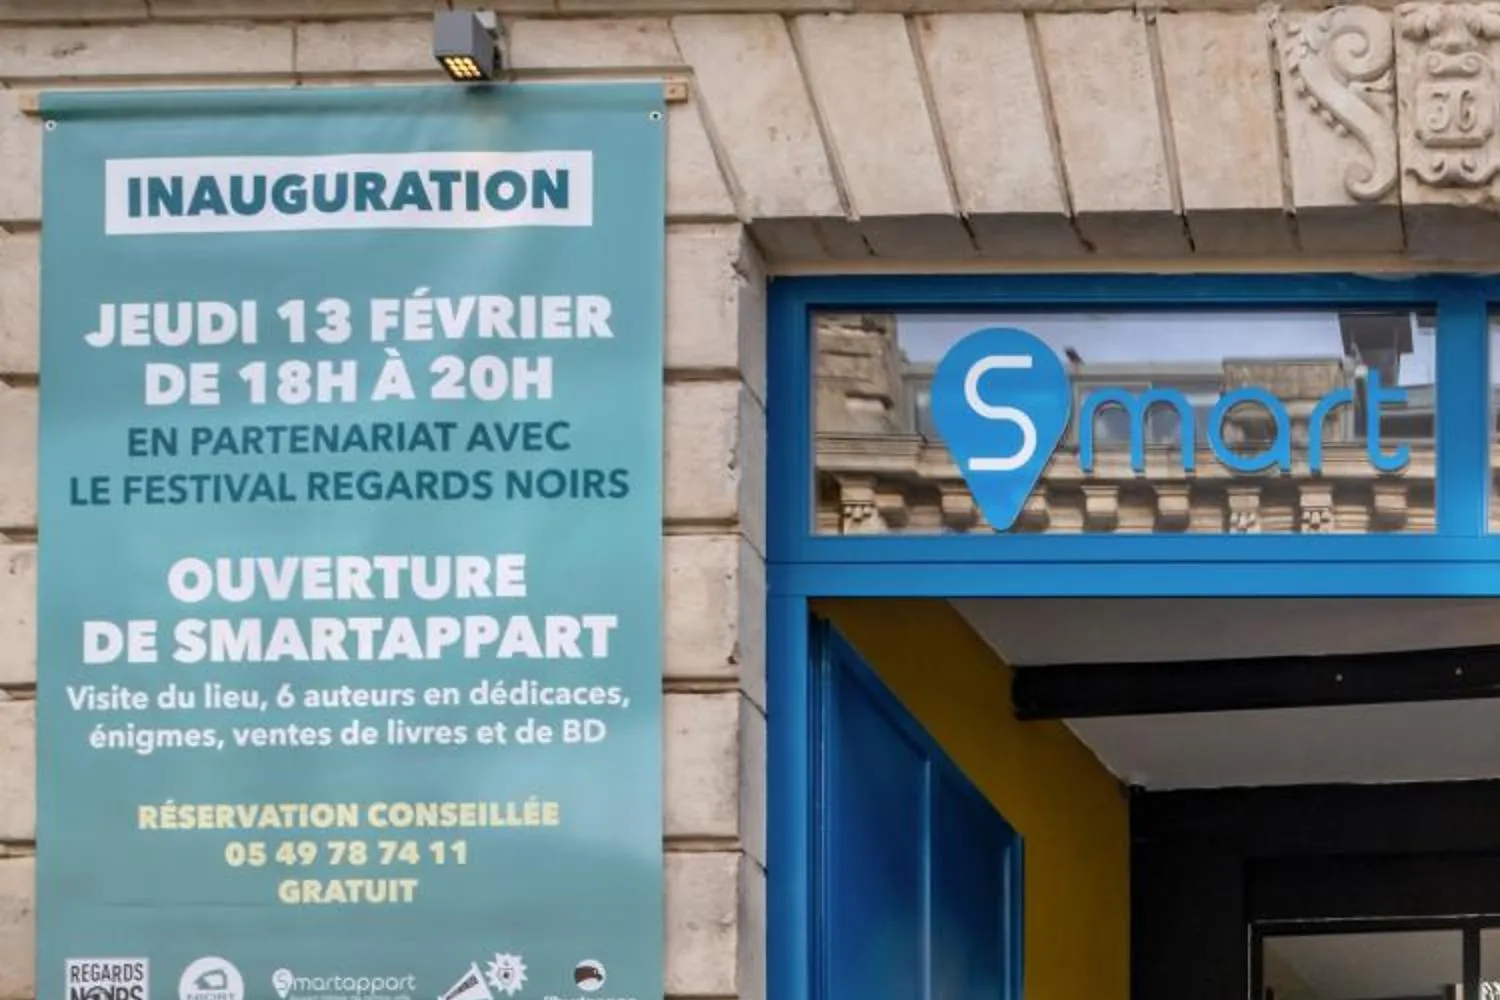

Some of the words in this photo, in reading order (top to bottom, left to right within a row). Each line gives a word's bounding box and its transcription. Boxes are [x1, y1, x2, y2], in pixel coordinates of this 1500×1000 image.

[127, 169, 570, 218] INAUGURATION
[85, 301, 257, 347] JEUDI
[277, 298, 352, 344] 13
[370, 287, 614, 343] FÉVRIER
[145, 362, 220, 406] DE
[239, 359, 357, 404] 18H
[372, 347, 415, 401] À
[431, 356, 553, 401] 20H
[966, 355, 1412, 474] Smart
[127, 427, 178, 457] EN
[191, 423, 457, 455] PARTENARIAT
[465, 421, 571, 452] AVEC
[70, 476, 115, 507] LE
[123, 473, 298, 505] FESTIVAL
[308, 470, 494, 501] REGARDS
[506, 468, 630, 500] NOIRS
[167, 554, 527, 602] OUVERTURE
[83, 620, 159, 664] DE
[172, 615, 618, 663] SMARTAPPART
[65, 685, 149, 711] Visite
[157, 684, 196, 710] du
[204, 683, 267, 712] lieu,
[276, 683, 295, 708] 6
[303, 687, 416, 708] auteurs
[423, 686, 461, 707] en
[469, 679, 631, 709] dédicaces,
[89, 723, 225, 756] énigmes,
[233, 725, 332, 747] ventes
[340, 722, 379, 747] de
[386, 720, 467, 746] livres
[475, 723, 508, 745] et
[515, 720, 554, 745] de
[563, 719, 606, 744] BD
[138, 799, 359, 830] RÉSERVATION
[367, 796, 559, 827] CONSEILLÉE
[225, 842, 267, 867] 05
[276, 842, 317, 866] 49
[327, 841, 367, 866] 78
[378, 841, 421, 865] 74
[429, 840, 468, 865] 11
[278, 878, 418, 904] GRATUIT
[70, 964, 144, 983] REGARDS
